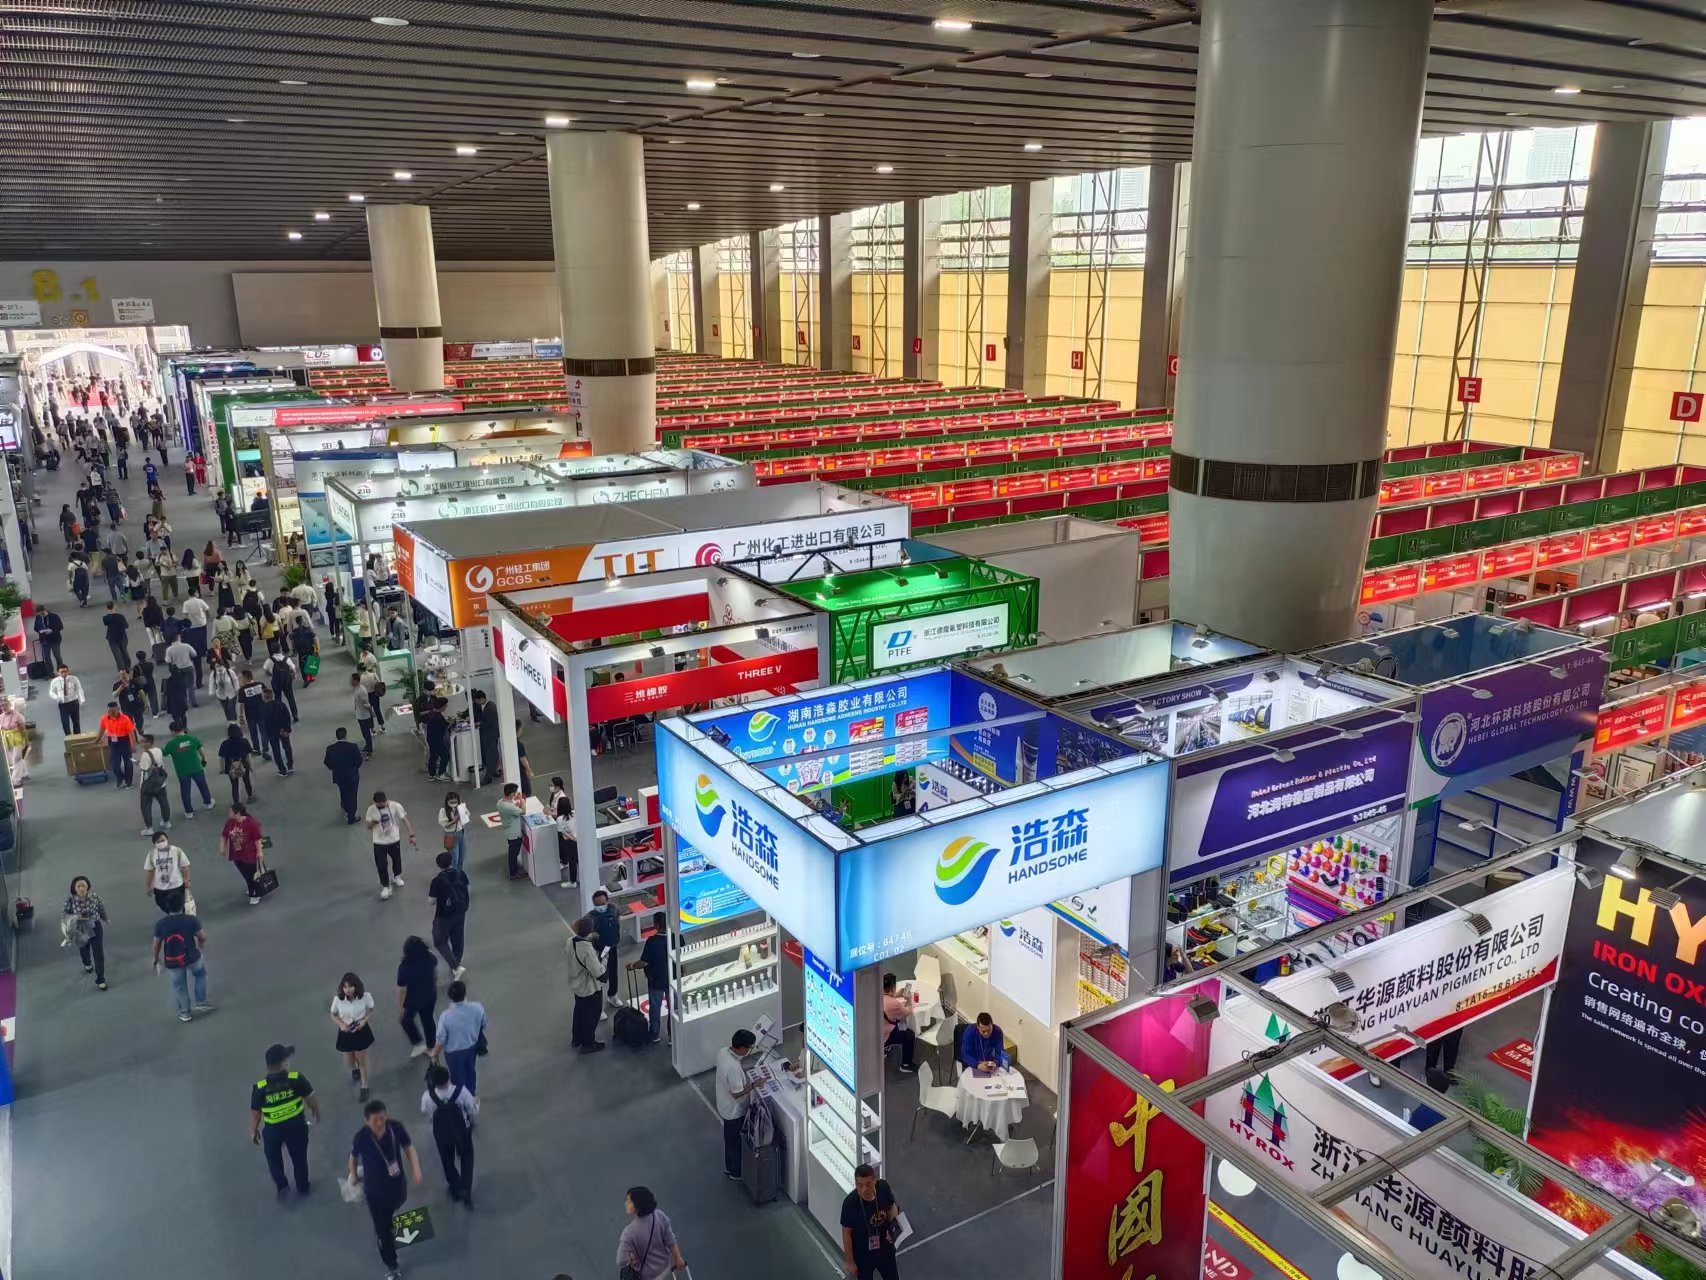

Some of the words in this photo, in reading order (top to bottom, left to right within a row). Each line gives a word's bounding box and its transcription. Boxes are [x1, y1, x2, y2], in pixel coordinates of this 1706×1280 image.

[914, 340, 921, 352] J
[1072, 352, 1082, 368] H
[1462, 380, 1478, 400] E
[1676, 395, 1698, 418] D
[613, 487, 671, 503] ZHECHEM
[732, 522, 886, 557] 广州化工进出口有限公司
[495, 560, 550, 577] 广州轻工集团
[496, 574, 533, 587] GCGS
[888, 646, 912, 659] PTFE
[518, 656, 542, 687] THREE
[541, 677, 547, 691] V
[737, 667, 774, 681] THREE
[775, 664, 783, 674] V
[787, 685, 908, 723] 湖南浩森胶业有限公司
[1150, 690, 1181, 708] ACTORY
[1181, 688, 1203, 702] SHOW
[1469, 682, 1591, 732] 河北环球科技股份有限公司
[1468, 732, 1489, 745] HEBEI
[1490, 723, 1518, 738] GLOBAL
[1519, 708, 1564, 728] TECHNOLOGY
[1324, 763, 1351, 777] Plastic
[731, 799, 779, 873] 浩森
[1010, 806, 1089, 867] 浩森
[731, 841, 780, 891] HANDSOME
[1008, 847, 1088, 885] HANDSOME
[1019, 926, 1044, 954] 浩森
[1313, 913, 1545, 1029] 华源颜料股份有限公司
[1378, 986, 1440, 1025] HUAYUAN
[1441, 962, 1494, 997] PIGMENT
[1520, 942, 1540, 960] LTD
[1592, 939, 1659, 983] IRON
[1664, 972, 1706, 1007] OX
[1588, 971, 1673, 1024] Creating
[1581, 1011, 1593, 1022] The
[1593, 1018, 1610, 1031] sales
[1610, 1027, 1637, 1043] network
[1637, 1038, 1643, 1047] is
[1644, 1042, 1667, 1058] spread
[1667, 1053, 1678, 1063] all
[1677, 1059, 1694, 1070] over
[1229, 1117, 1297, 1173] HYROX
[1310, 1158, 1403, 1233] ZHIANG
[1408, 1225, 1492, 1280] HUAYU
